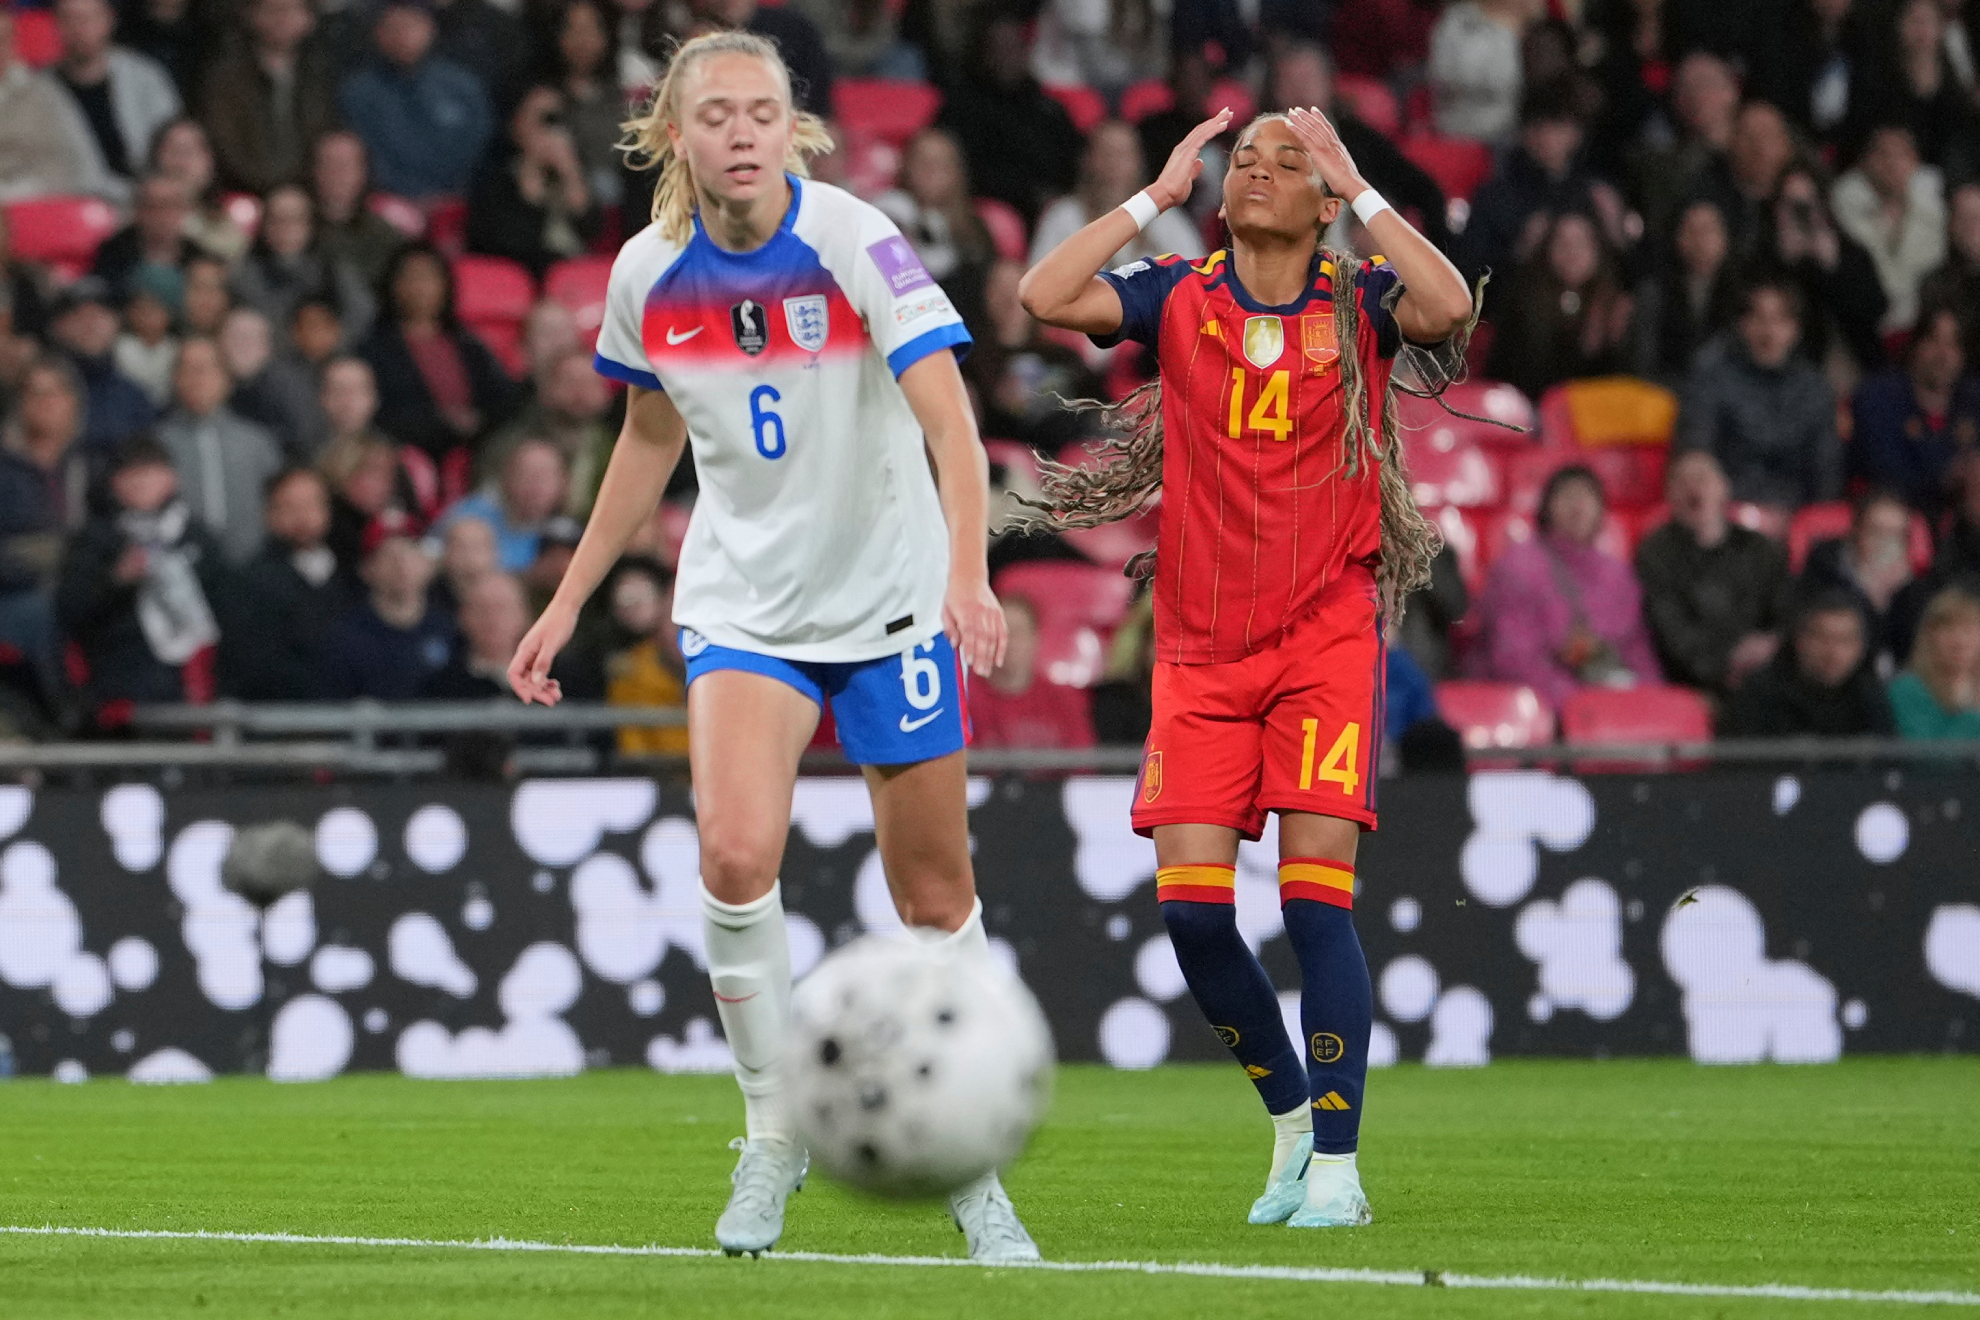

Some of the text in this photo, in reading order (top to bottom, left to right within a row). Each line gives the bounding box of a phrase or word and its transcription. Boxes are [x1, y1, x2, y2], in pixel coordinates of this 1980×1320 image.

[749, 385, 786, 460] 6
[1228, 367, 1293, 441] 14
[901, 638, 941, 710] 6
[1299, 718, 1360, 796] 14
